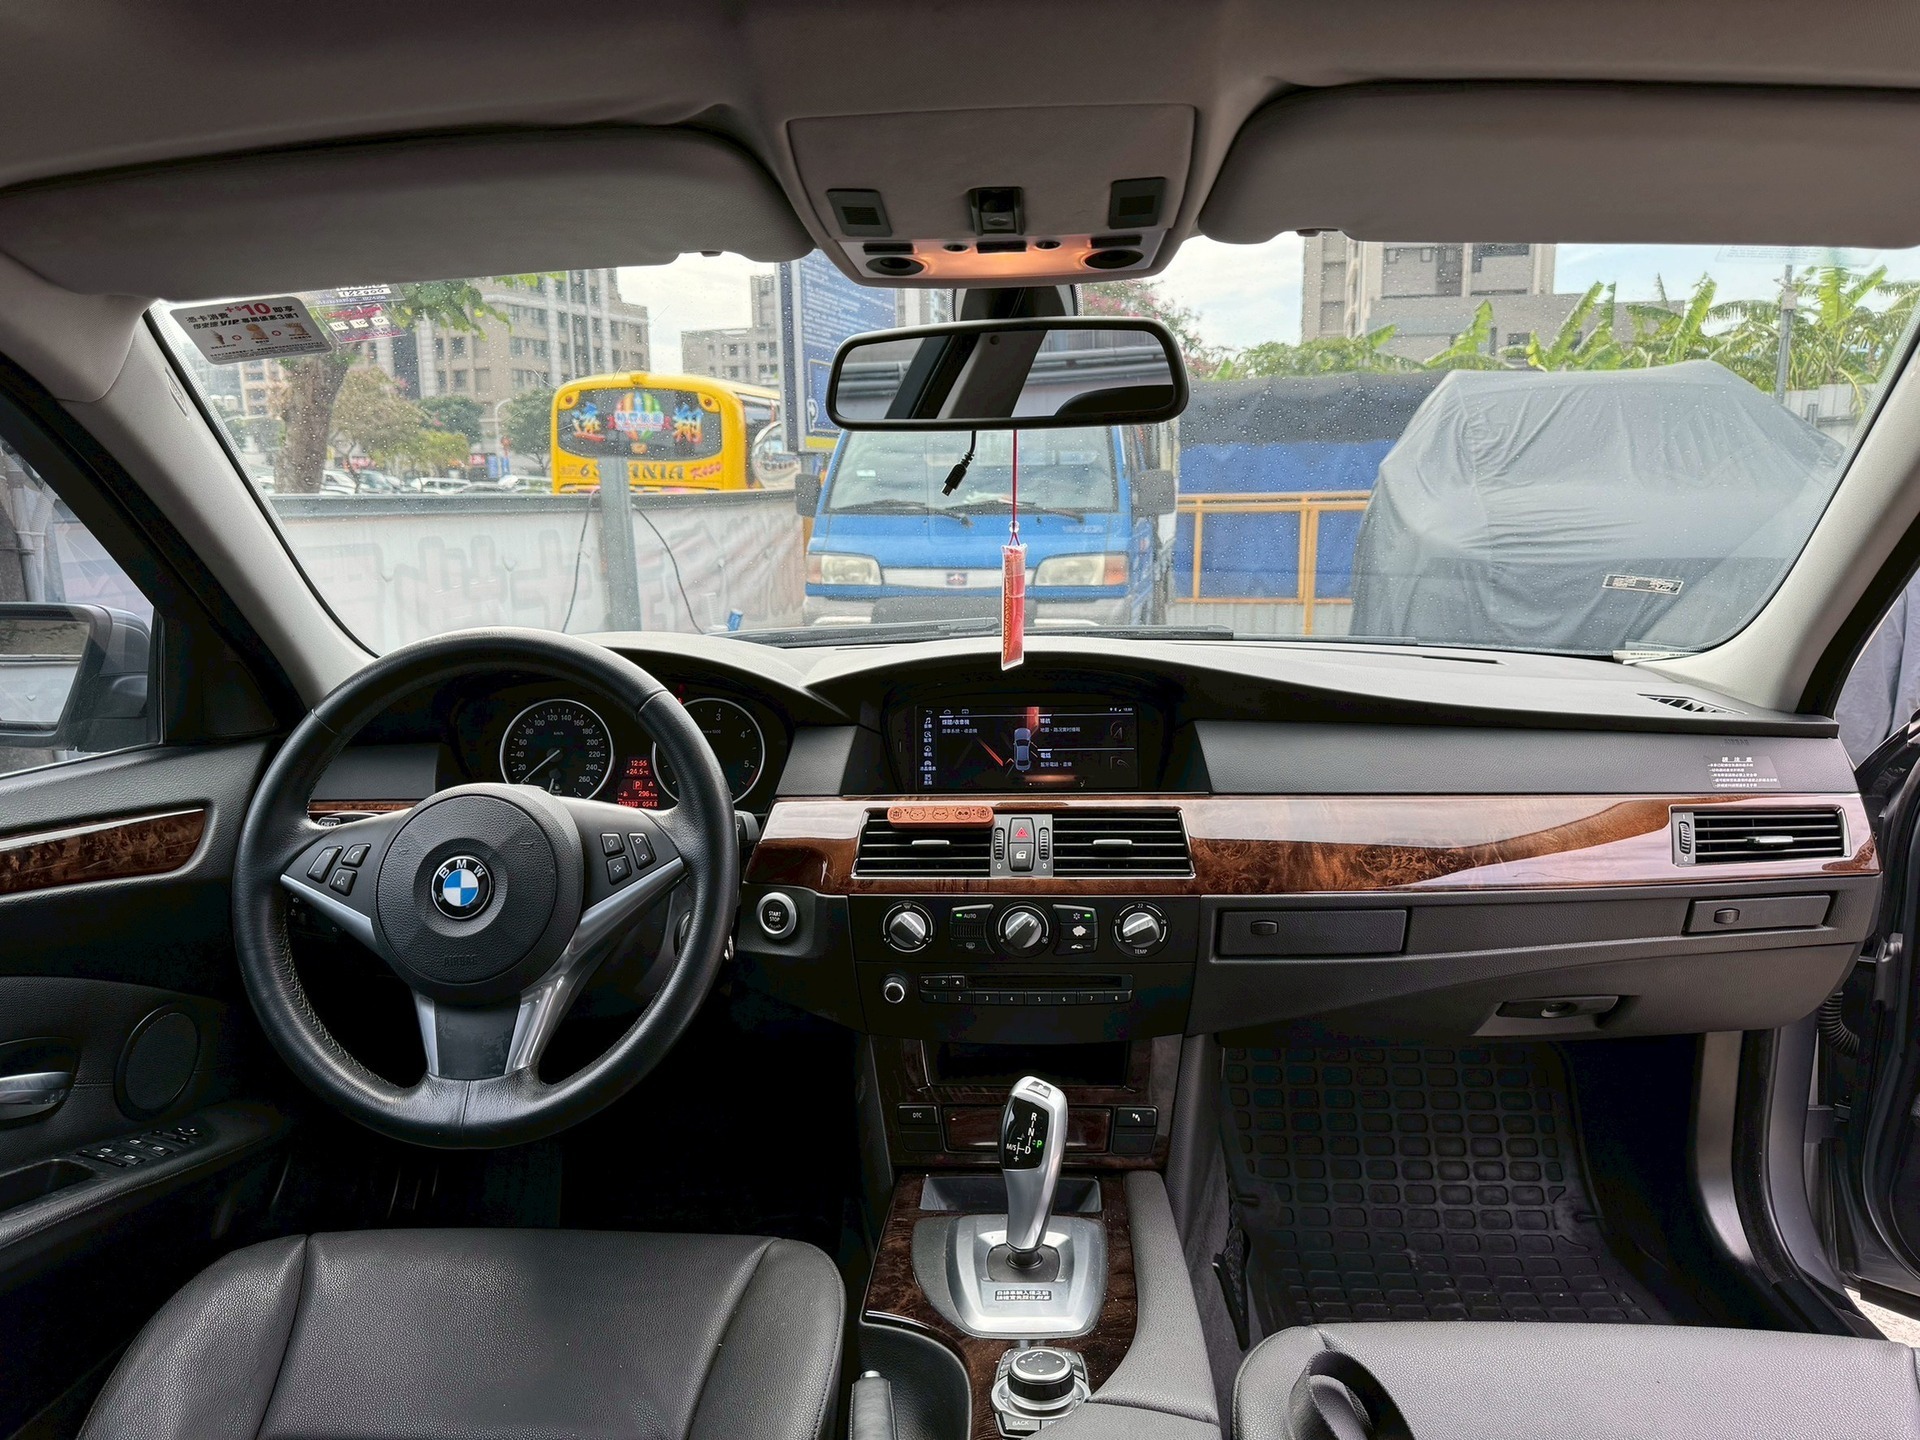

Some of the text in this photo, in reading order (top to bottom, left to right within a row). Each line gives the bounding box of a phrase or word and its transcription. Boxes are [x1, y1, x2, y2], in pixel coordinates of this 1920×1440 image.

[716, 713, 721, 721] 3
[744, 760, 750, 768] 5
[439, 859, 485, 879] BMW
[1031, 1112, 1038, 1121] R
[1028, 1127, 1035, 1137] N
[1006, 1143, 1016, 1152] M/S
[1036, 1140, 1042, 1148] P
[1024, 1146, 1031, 1155] D
